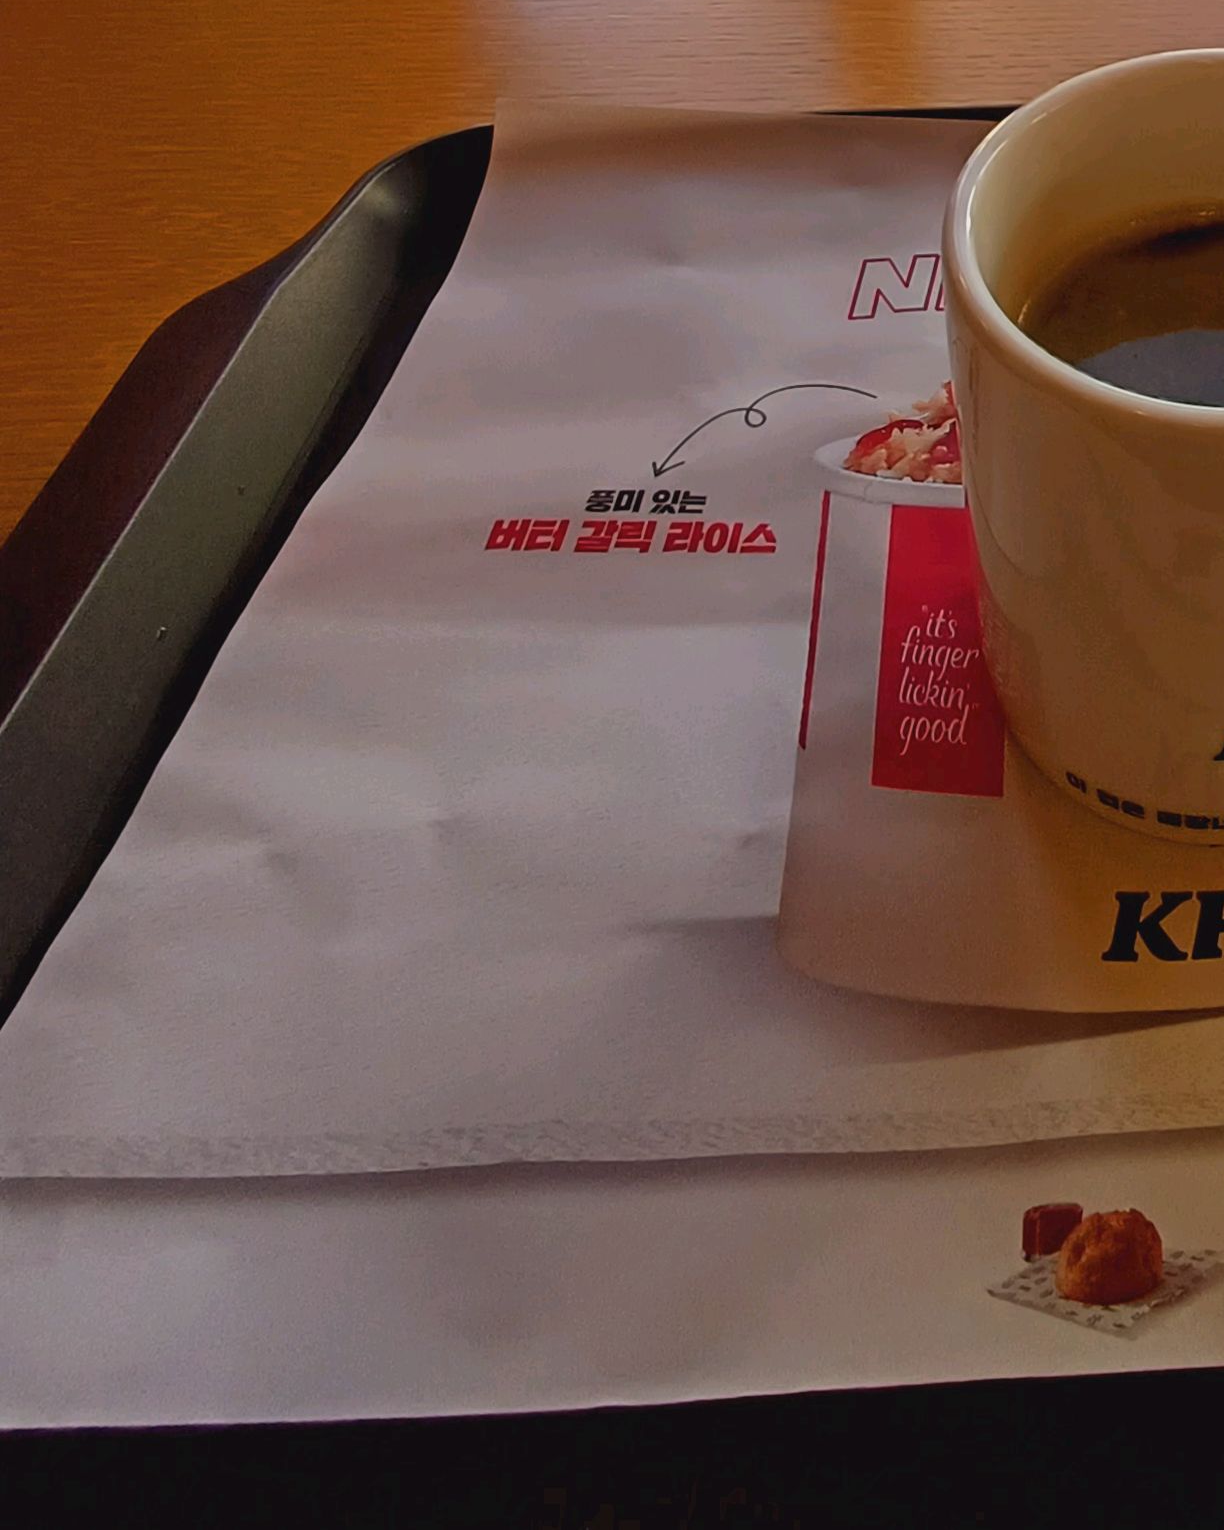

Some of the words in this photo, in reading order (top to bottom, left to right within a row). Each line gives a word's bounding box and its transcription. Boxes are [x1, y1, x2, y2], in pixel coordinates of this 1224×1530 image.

[585, 490, 645, 513] 풍미
[649, 490, 707, 514] 있는
[485, 519, 570, 551] 버터
[573, 520, 657, 553] 갈릭
[662, 521, 777, 553] 라이스
[901, 625, 980, 680] finger
[900, 704, 967, 756] good
